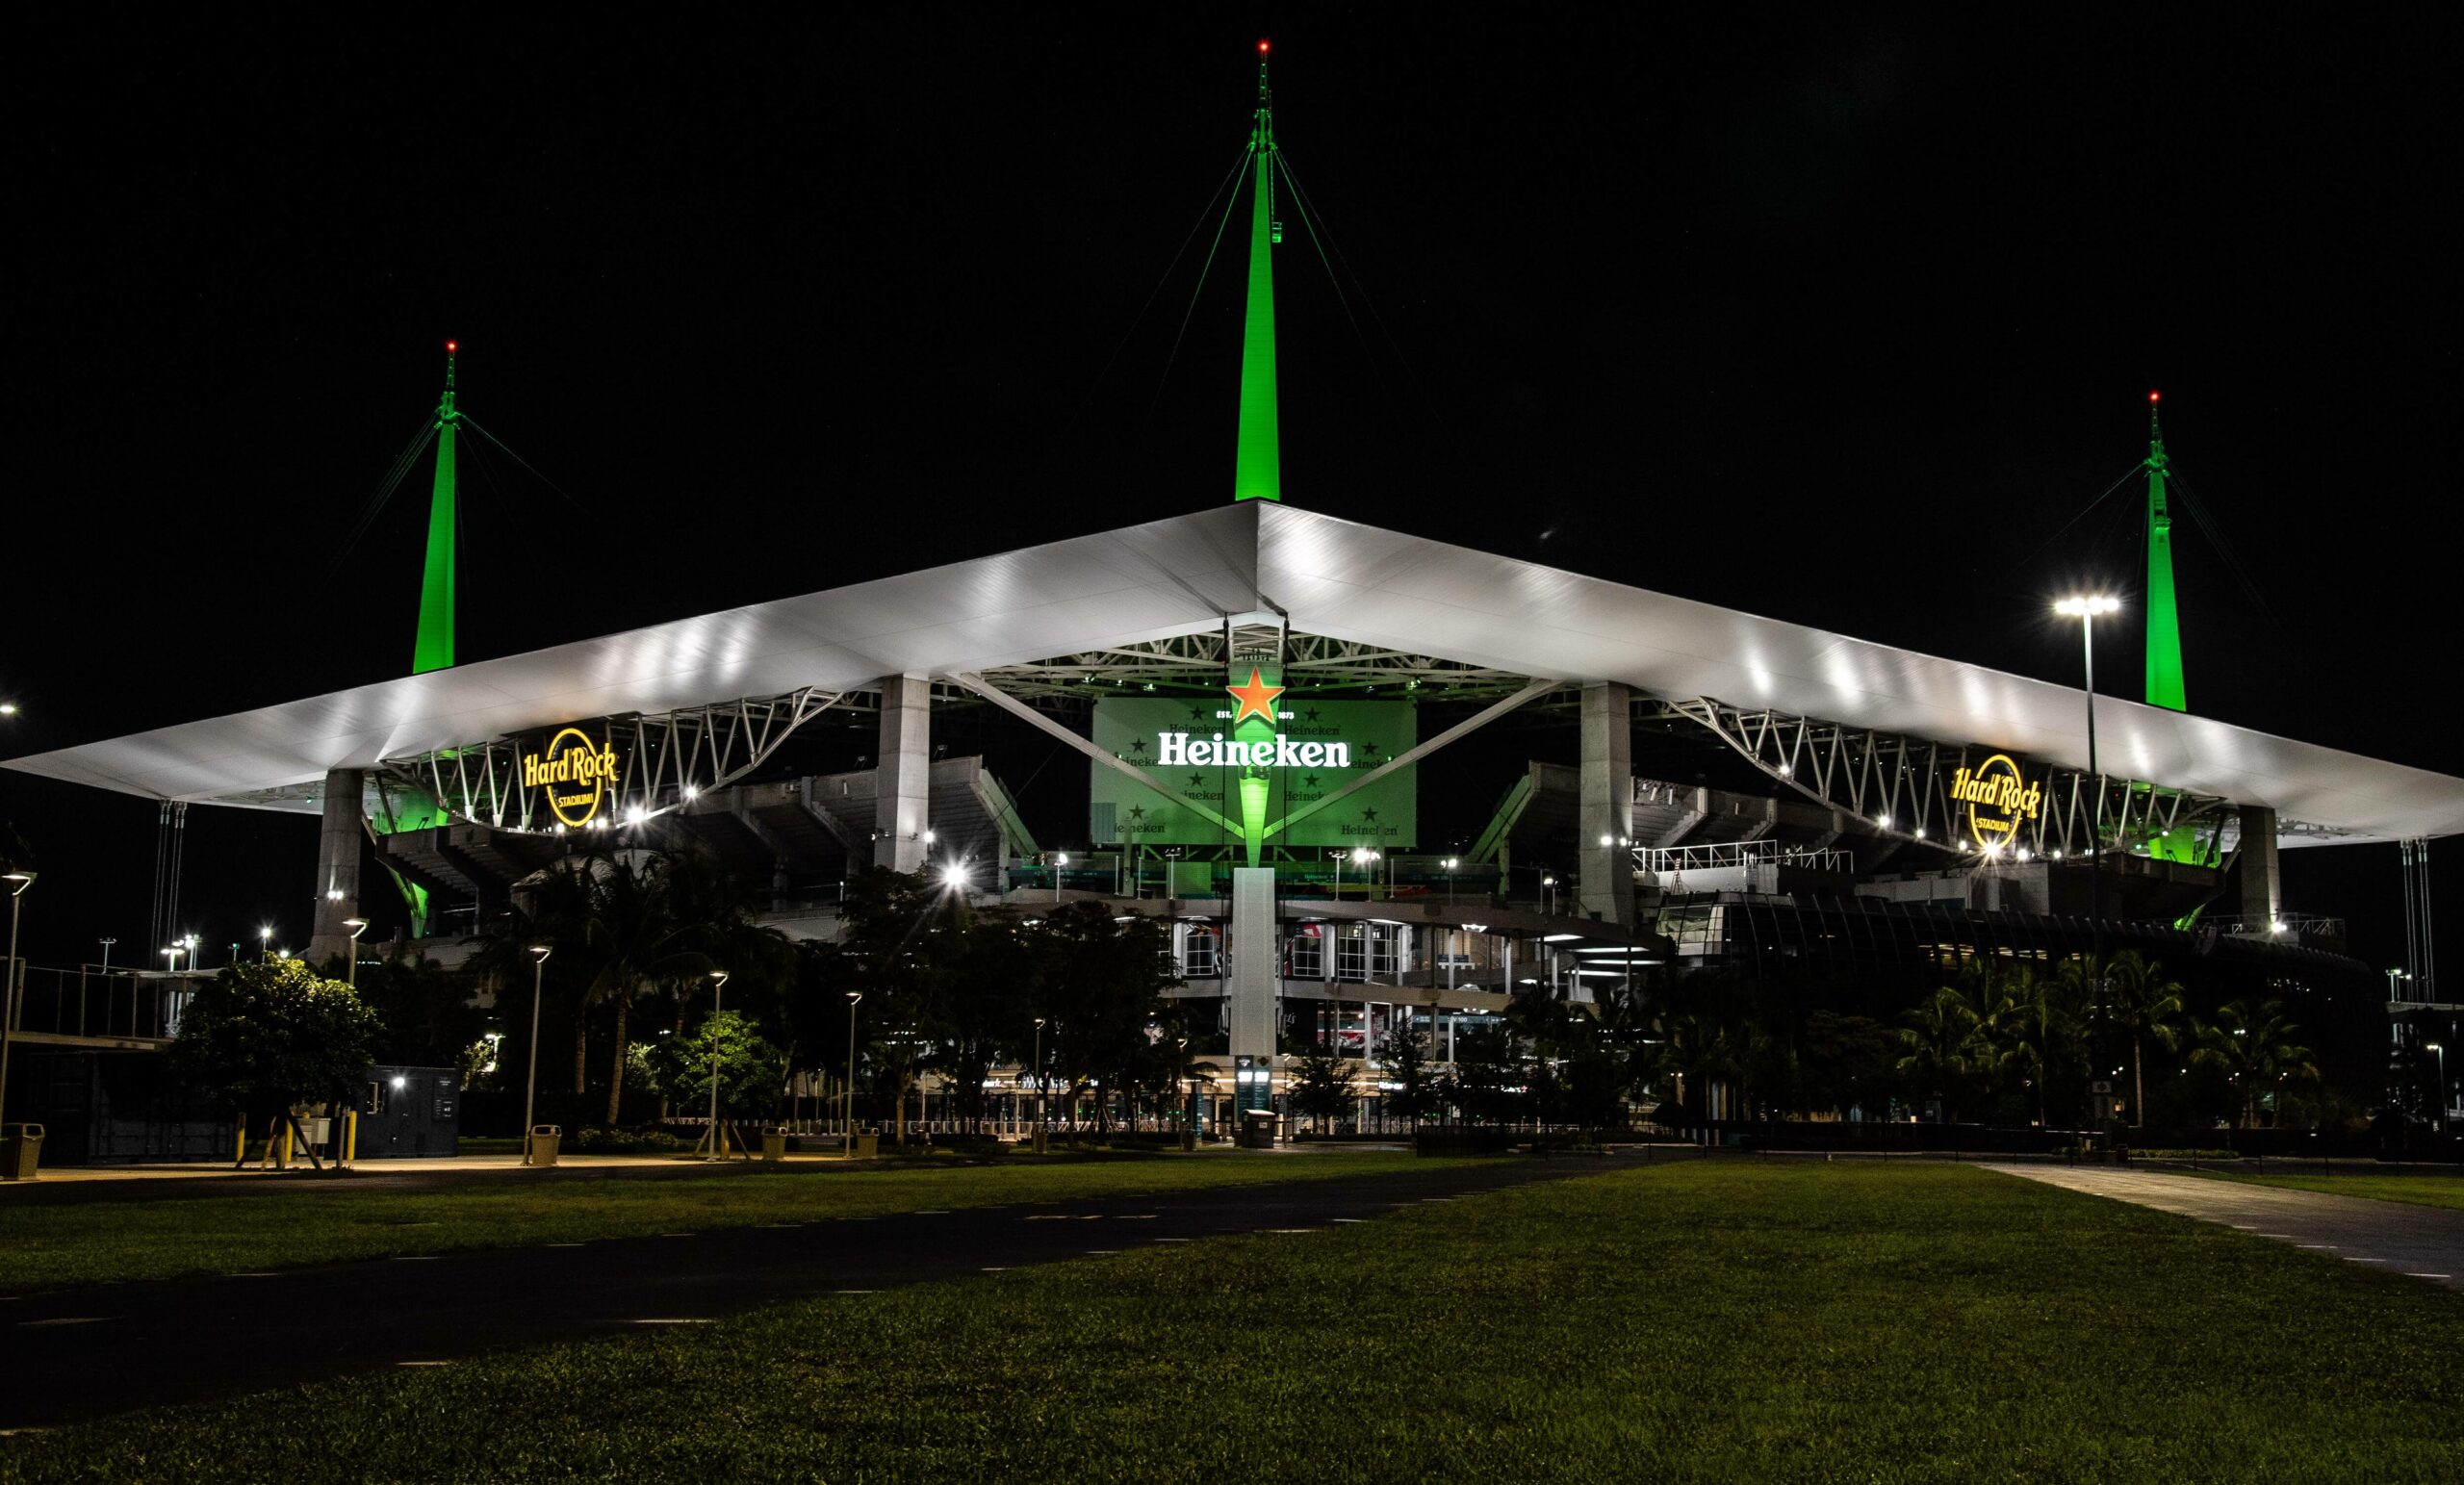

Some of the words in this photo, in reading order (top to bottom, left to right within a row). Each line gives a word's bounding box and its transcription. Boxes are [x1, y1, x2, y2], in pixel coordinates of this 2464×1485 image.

[1169, 724, 1224, 734] Heineken
[1285, 725, 1340, 735] Heineken
[1158, 732, 1350, 767] Heineken
[524, 748, 569, 787] Hard
[571, 742, 620, 786] Rock
[557, 793, 594, 807] STADIUM
[1285, 791, 1325, 802] Heinek
[1951, 767, 2001, 805] Hard
[1997, 776, 2040, 819] Rock
[1977, 818, 2010, 832] STADIUM
